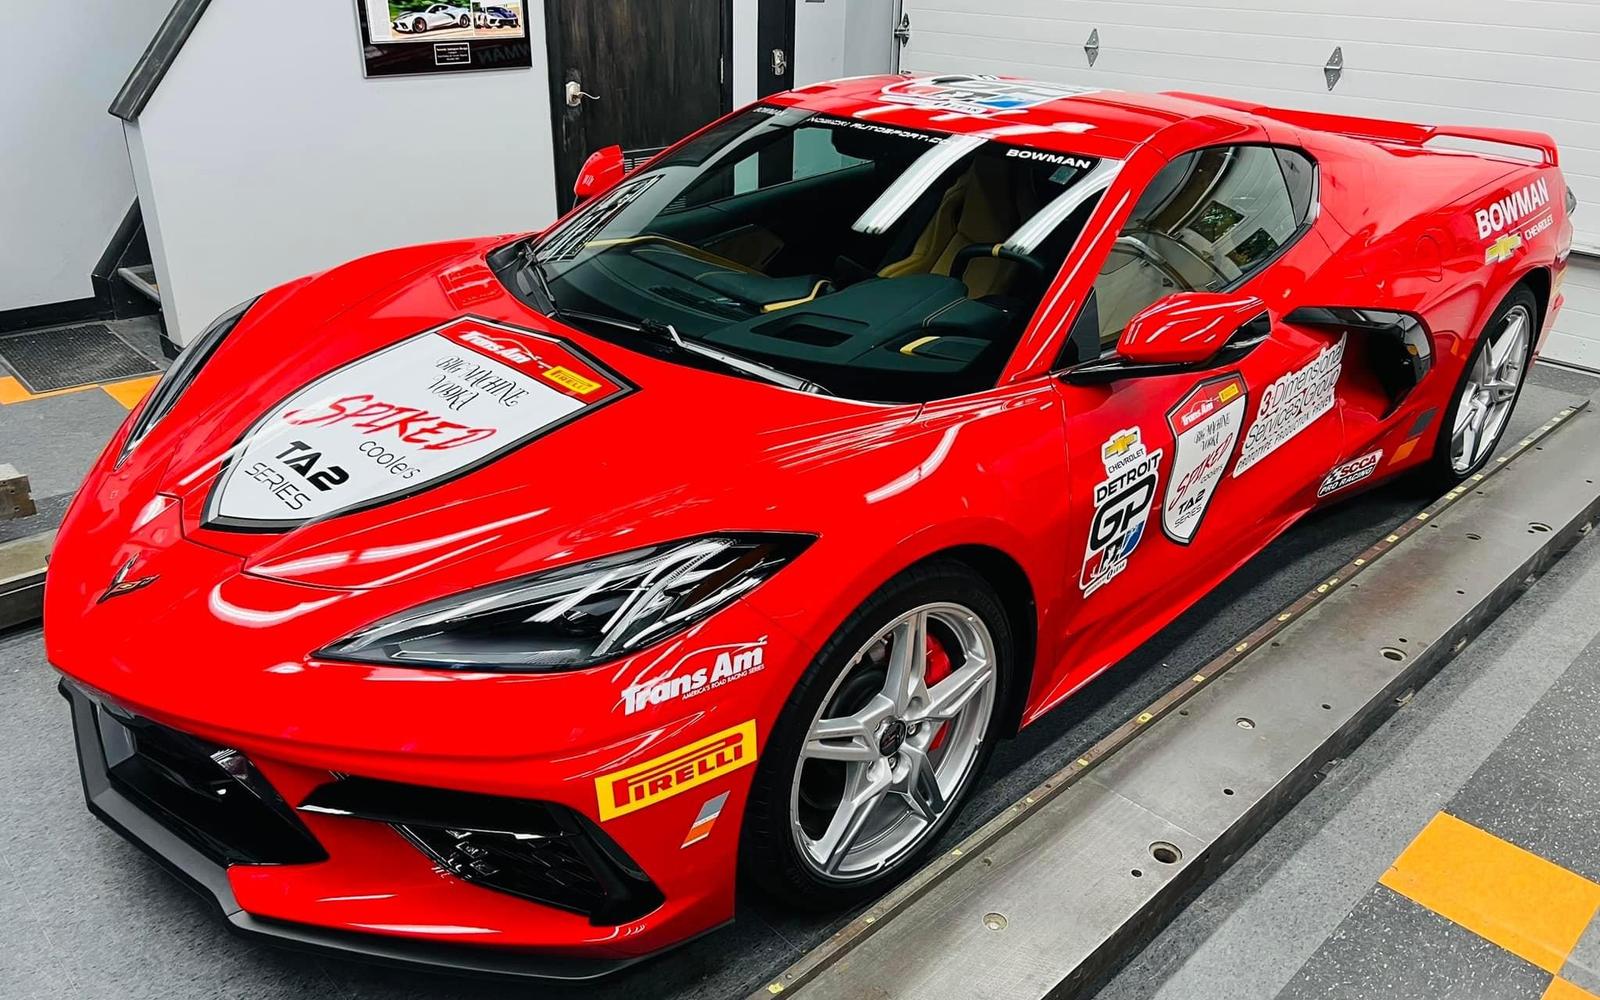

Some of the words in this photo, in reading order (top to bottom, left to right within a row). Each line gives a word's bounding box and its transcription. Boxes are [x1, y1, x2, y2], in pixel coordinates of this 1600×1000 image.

[1006, 148, 1091, 170] BOWMAN
[1475, 177, 1550, 240] BOWMAN
[1524, 214, 1553, 240] CHEVROLET
[427, 374, 480, 411] VODKA
[458, 363, 530, 407] MACHINE
[549, 368, 594, 392] PIRELLI
[283, 394, 498, 451] SPIKED
[1245, 398, 1301, 450] Services
[275, 440, 350, 492] TA2
[358, 440, 421, 480] coolers
[1095, 452, 1161, 504] DETROIT
[1107, 448, 1145, 474] CHEVROLET
[1167, 432, 1234, 512] SPIKED
[1319, 481, 1340, 496] PRO
[1338, 465, 1374, 487] RACING
[1340, 454, 1377, 477] SCCA
[245, 462, 312, 510] SERIES
[1178, 488, 1206, 516] TA2
[1090, 473, 1156, 551] GP
[1174, 504, 1202, 528] SERIES
[620, 666, 708, 716] Trans
[709, 647, 764, 683] Am
[682, 684, 711, 701] AMERICA'S
[711, 678, 727, 690] ROAD
[727, 670, 748, 683] RACING
[748, 663, 766, 675] SERIES
[612, 732, 744, 809] PIRELLI
